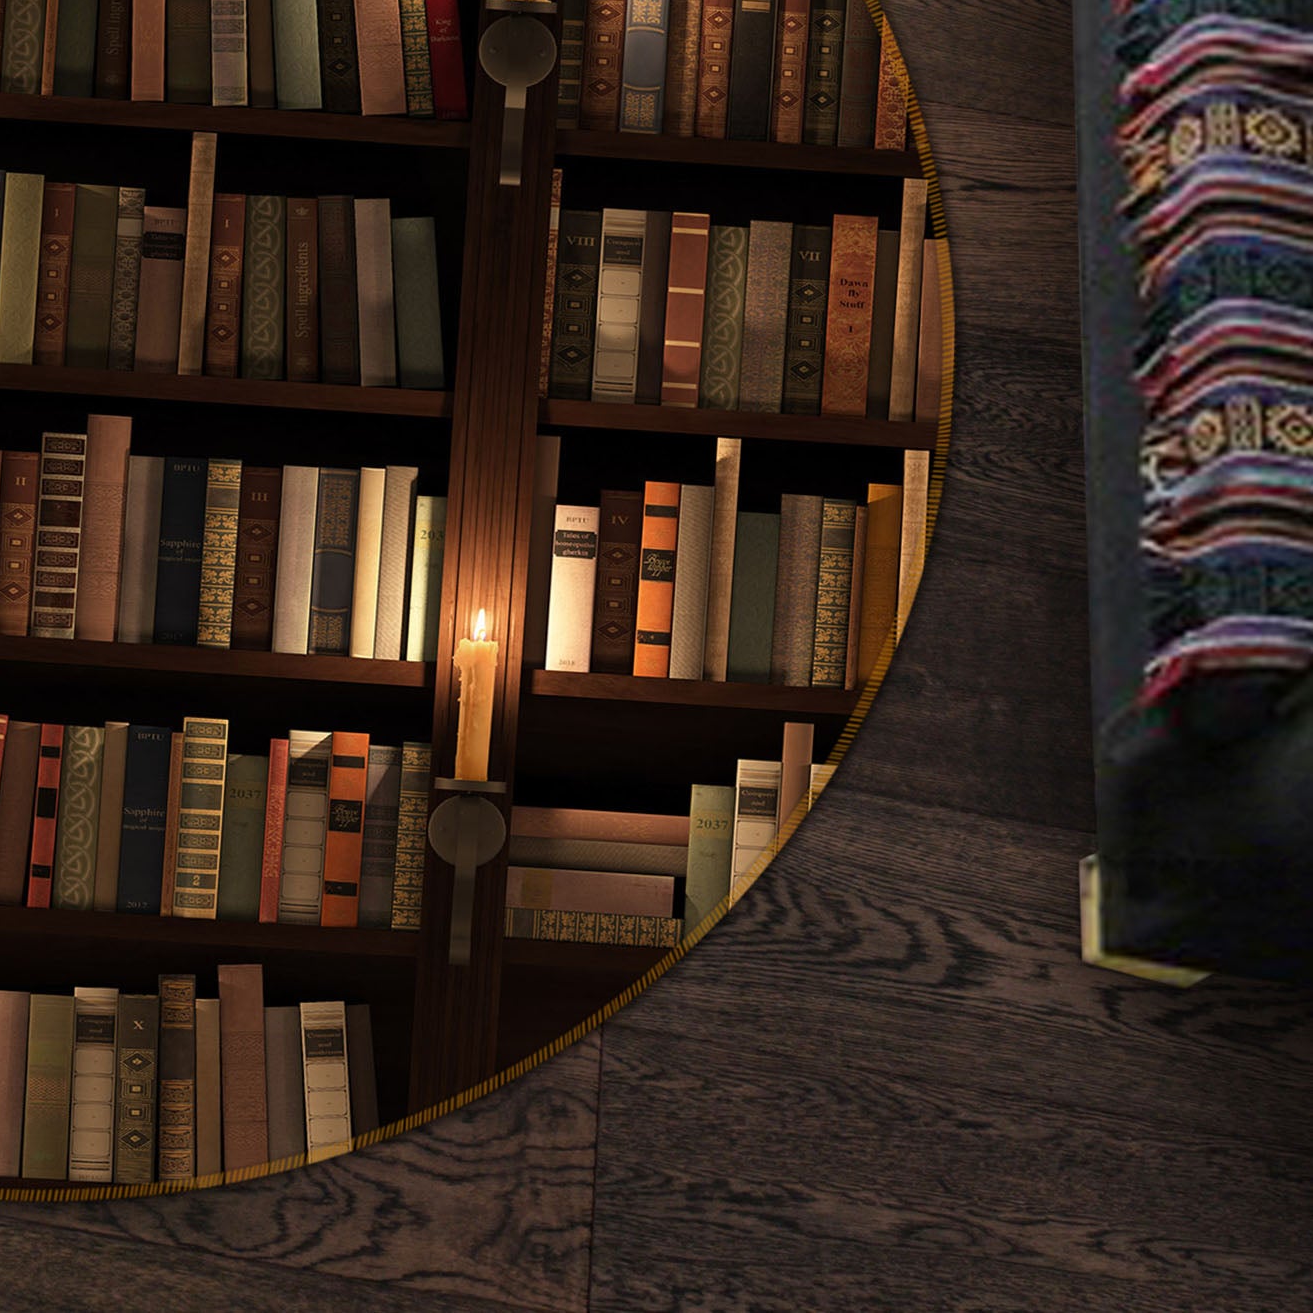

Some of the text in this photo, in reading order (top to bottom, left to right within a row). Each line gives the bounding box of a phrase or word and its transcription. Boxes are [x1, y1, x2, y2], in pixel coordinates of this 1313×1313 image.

[566, 236, 595, 246] VIII
[799, 251, 821, 261] VII
[15, 477, 26, 485] II
[251, 492, 268, 501] III
[610, 516, 629, 526] IV
[230, 789, 262, 799] 2037
[124, 806, 165, 817] Sapphire
[696, 819, 729, 829] 2037
[134, 1021, 143, 1030] X
